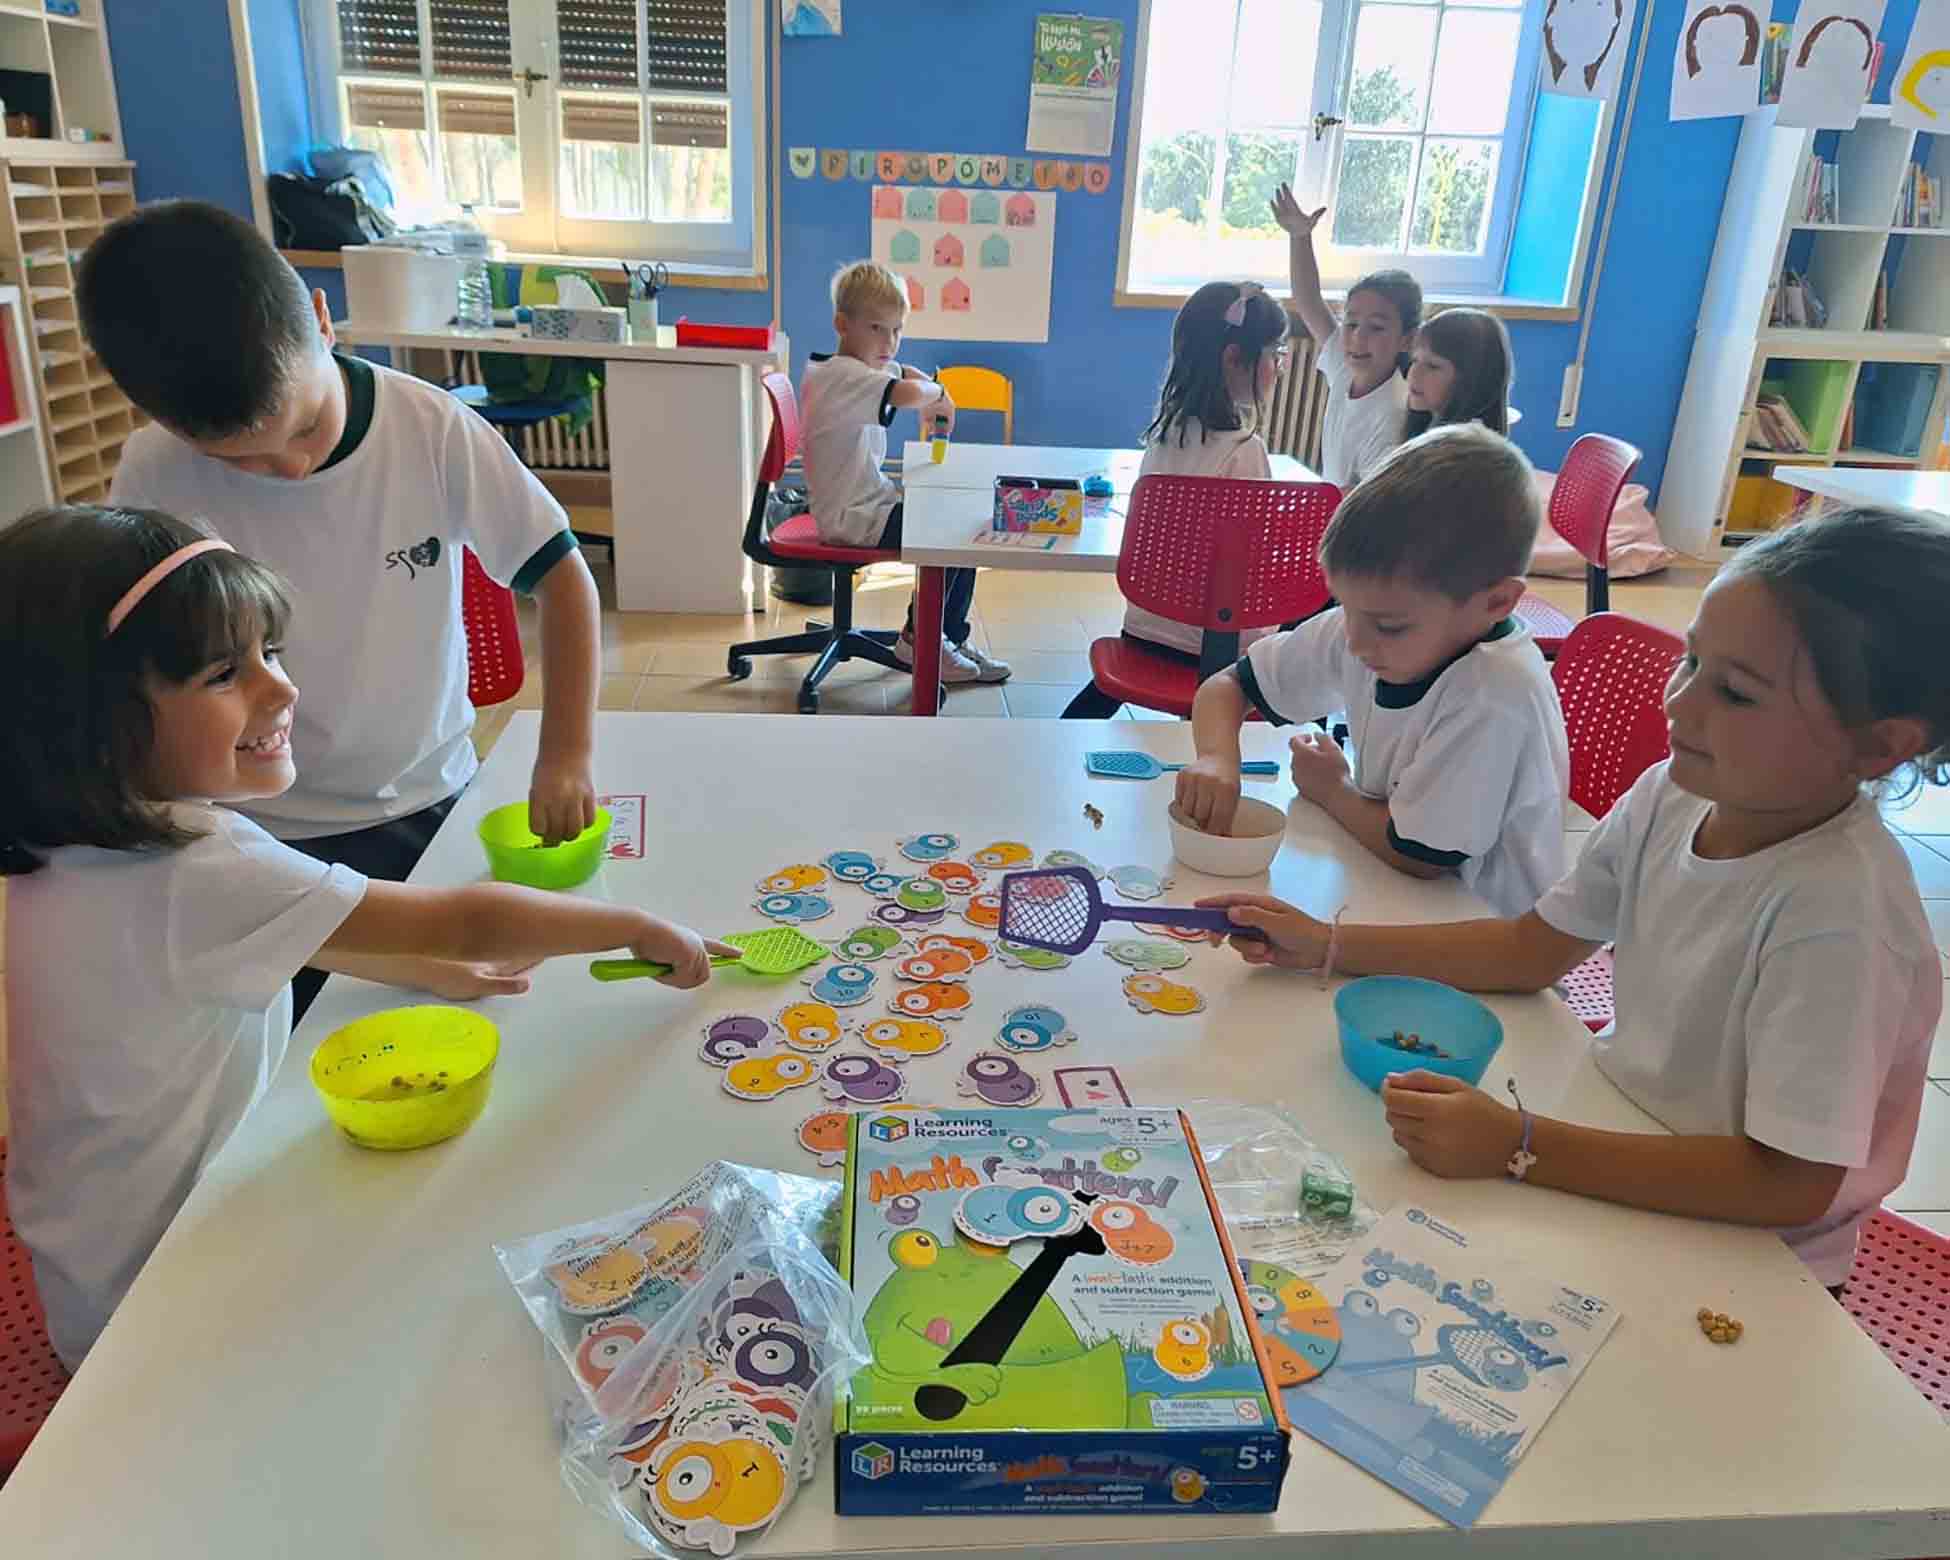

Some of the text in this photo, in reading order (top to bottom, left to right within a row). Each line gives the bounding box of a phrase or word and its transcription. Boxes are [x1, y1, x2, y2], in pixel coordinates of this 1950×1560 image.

[914, 1117, 993, 1128] Learning
[1137, 1117, 1172, 1134] 5+
[914, 1127, 1008, 1137] Resources
[868, 1153, 980, 1204] Math
[1073, 1285, 1098, 1294] and
[1100, 1285, 1174, 1296] subtraction
[899, 1445, 984, 1460] Learning
[1236, 1445, 1277, 1470] 5+
[899, 1460, 998, 1473] Resources
